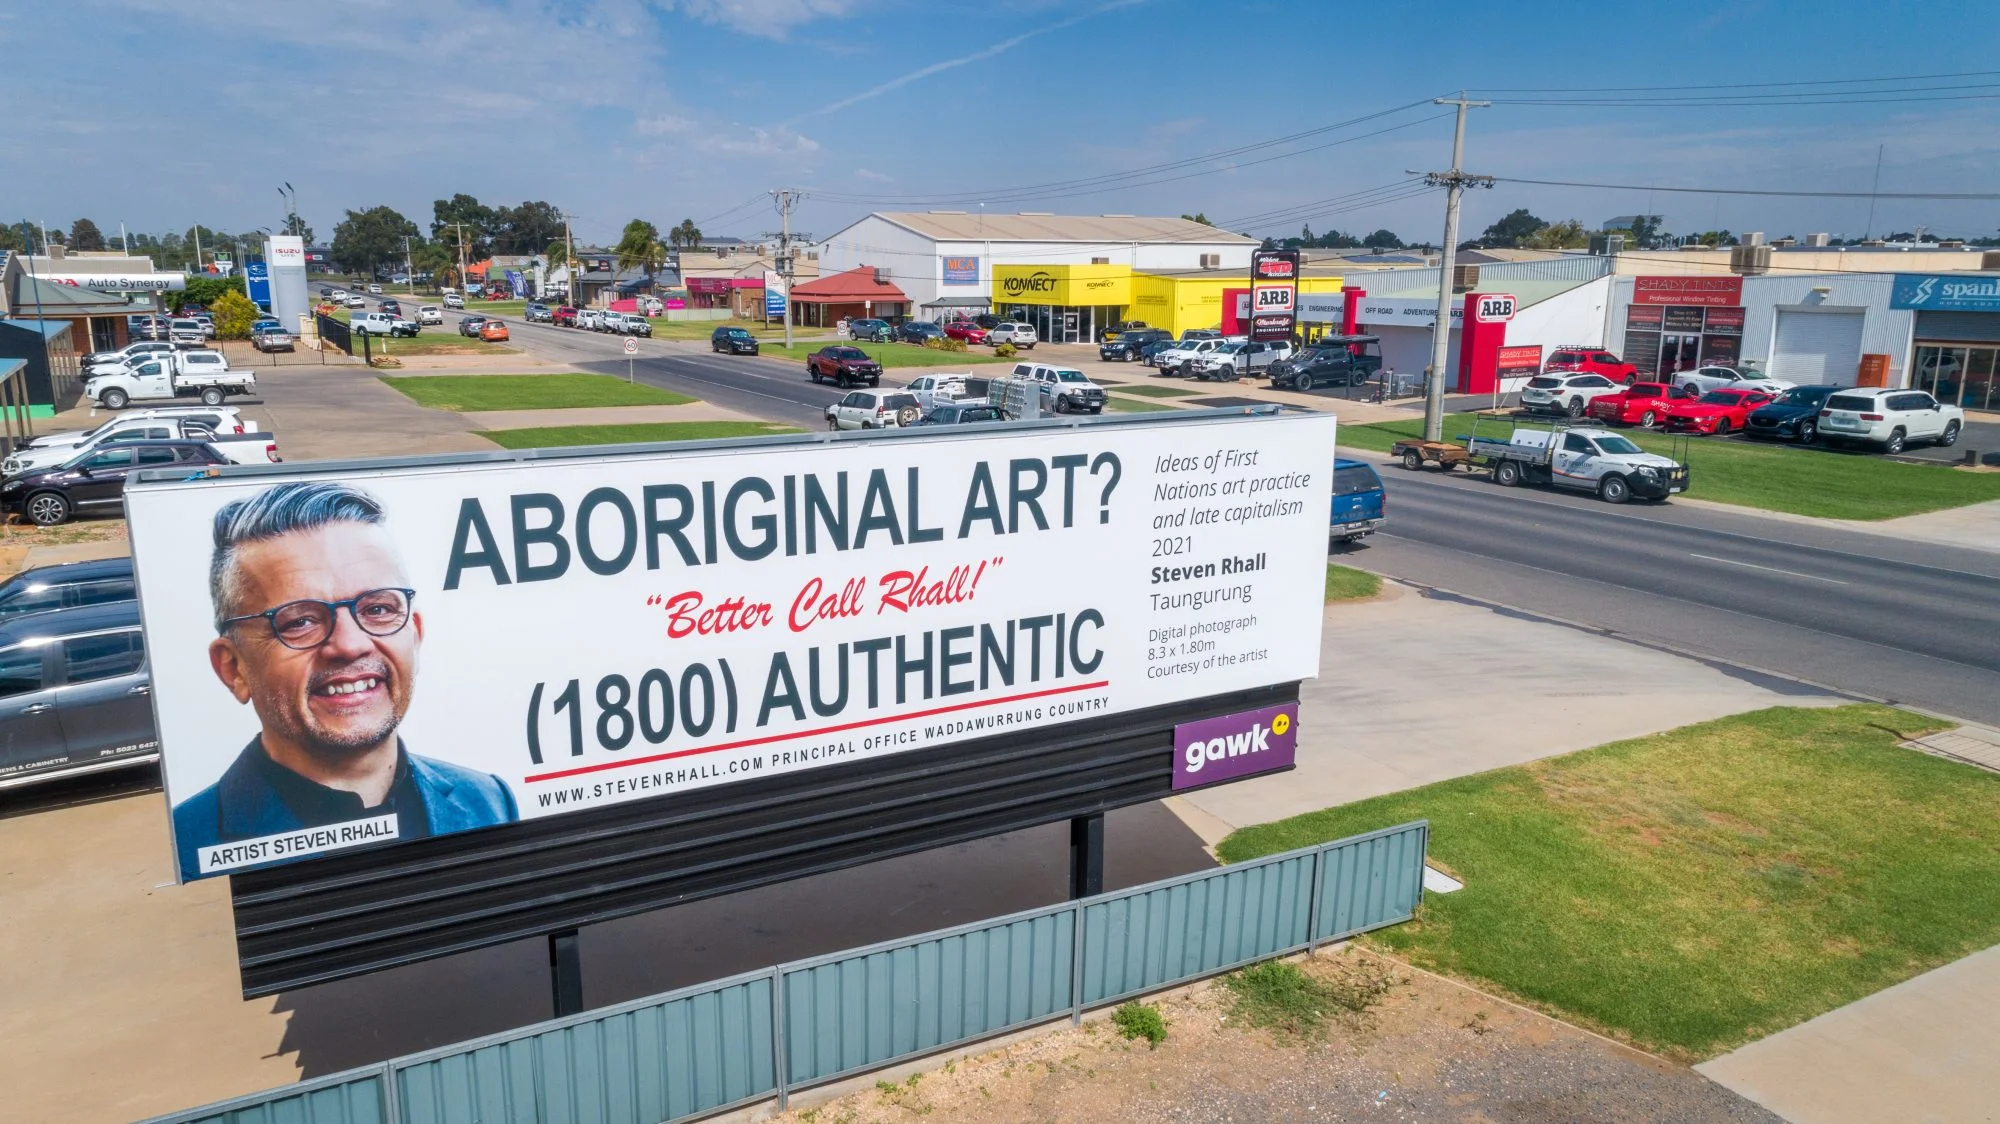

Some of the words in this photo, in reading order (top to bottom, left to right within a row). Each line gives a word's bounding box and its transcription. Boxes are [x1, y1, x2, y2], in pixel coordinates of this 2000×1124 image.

[947, 258, 975, 271] MCA
[88, 278, 117, 287] Auto
[121, 278, 170, 289] Synergy
[1003, 277, 1057, 291] KONNECT
[1637, 279, 1688, 291] SHADY
[1692, 280, 1737, 292] TINTS
[1259, 290, 1290, 306] ARB
[1309, 305, 1344, 313] ENGINEERING
[1481, 300, 1512, 316] ARB
[1706, 296, 1727, 304] Tinting
[1378, 307, 1393, 315] ROAD
[1450, 310, 1464, 318] ARB
[1155, 453, 1199, 474] Ideas
[1204, 449, 1223, 474] of
[1225, 449, 1259, 468] First
[1154, 481, 1217, 502] Nations
[1222, 477, 1246, 495] art
[1248, 471, 1311, 498] practice
[443, 466, 944, 591] ABORIGINAL
[957, 451, 1122, 539] ART?
[1153, 508, 1186, 530] and
[1190, 507, 1220, 526] late
[1224, 499, 1303, 525] capitalism
[1152, 536, 1192, 557] 2021
[1151, 562, 1216, 584] Steven
[1221, 552, 1266, 575] Rhall
[788, 575, 866, 633] Call
[1150, 584, 1252, 611] Taungurung
[1149, 624, 1187, 643] Digital
[1189, 614, 1257, 638] photograph
[1147, 646, 1166, 661] 8.3
[1169, 647, 1176, 657] x
[1180, 639, 1216, 656] 1.80m
[1147, 660, 1200, 679] Courtesy
[1203, 655, 1216, 669] of
[1217, 653, 1236, 667] the
[1239, 648, 1268, 663] artist
[526, 657, 738, 765] (1800)
[755, 607, 1105, 727] AUTHENTIC
[538, 756, 763, 807] WWW.STEVENRHALL.COM
[771, 740, 855, 767] PRINCIPAL
[864, 730, 917, 750] OFFICE
[924, 707, 1042, 740] WADDAWURRUNG
[1049, 696, 1110, 717] COUNTRY
[1185, 723, 1271, 773] gawk
[25, 756, 69, 769] CABINETRY
[210, 841, 269, 867] ARTIST
[274, 829, 337, 854] STEVEN
[341, 819, 394, 842] RHALL
